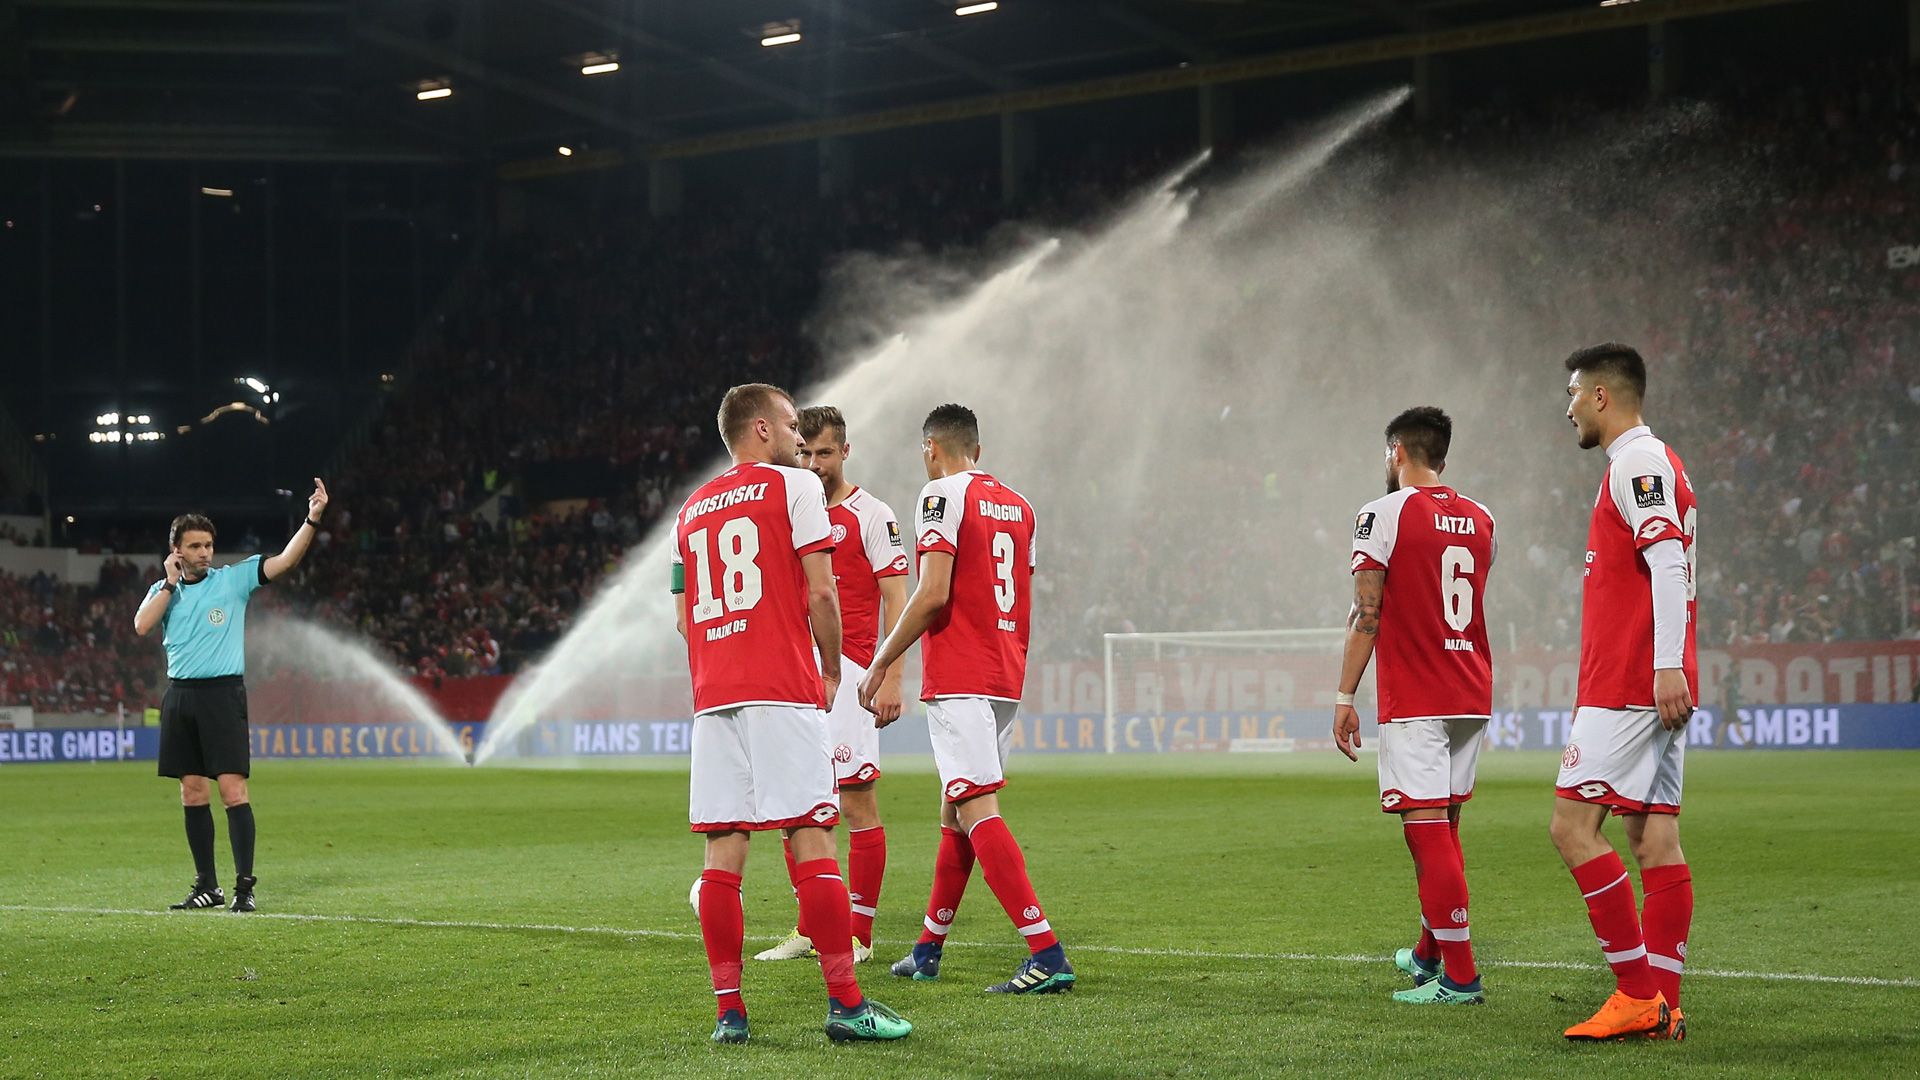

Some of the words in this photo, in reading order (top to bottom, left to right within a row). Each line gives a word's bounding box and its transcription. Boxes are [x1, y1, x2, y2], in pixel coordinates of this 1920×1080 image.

[684, 482, 768, 525] BROSINSKI
[979, 500, 1023, 522] BALOGUN
[1638, 492, 1661, 503] MFD
[923, 509, 941, 518] MFD
[1434, 513, 1475, 535] LATZA
[688, 516, 763, 624] 18
[992, 531, 1016, 613] 3
[1441, 545, 1475, 632] 6
[733, 619, 748, 633] 05
[574, 722, 640, 753] HANS
[650, 722, 691, 752] TEI
[1728, 709, 1840, 745] GMBH
[0, 732, 55, 760] ELER
[62, 730, 135, 758] GMBH
